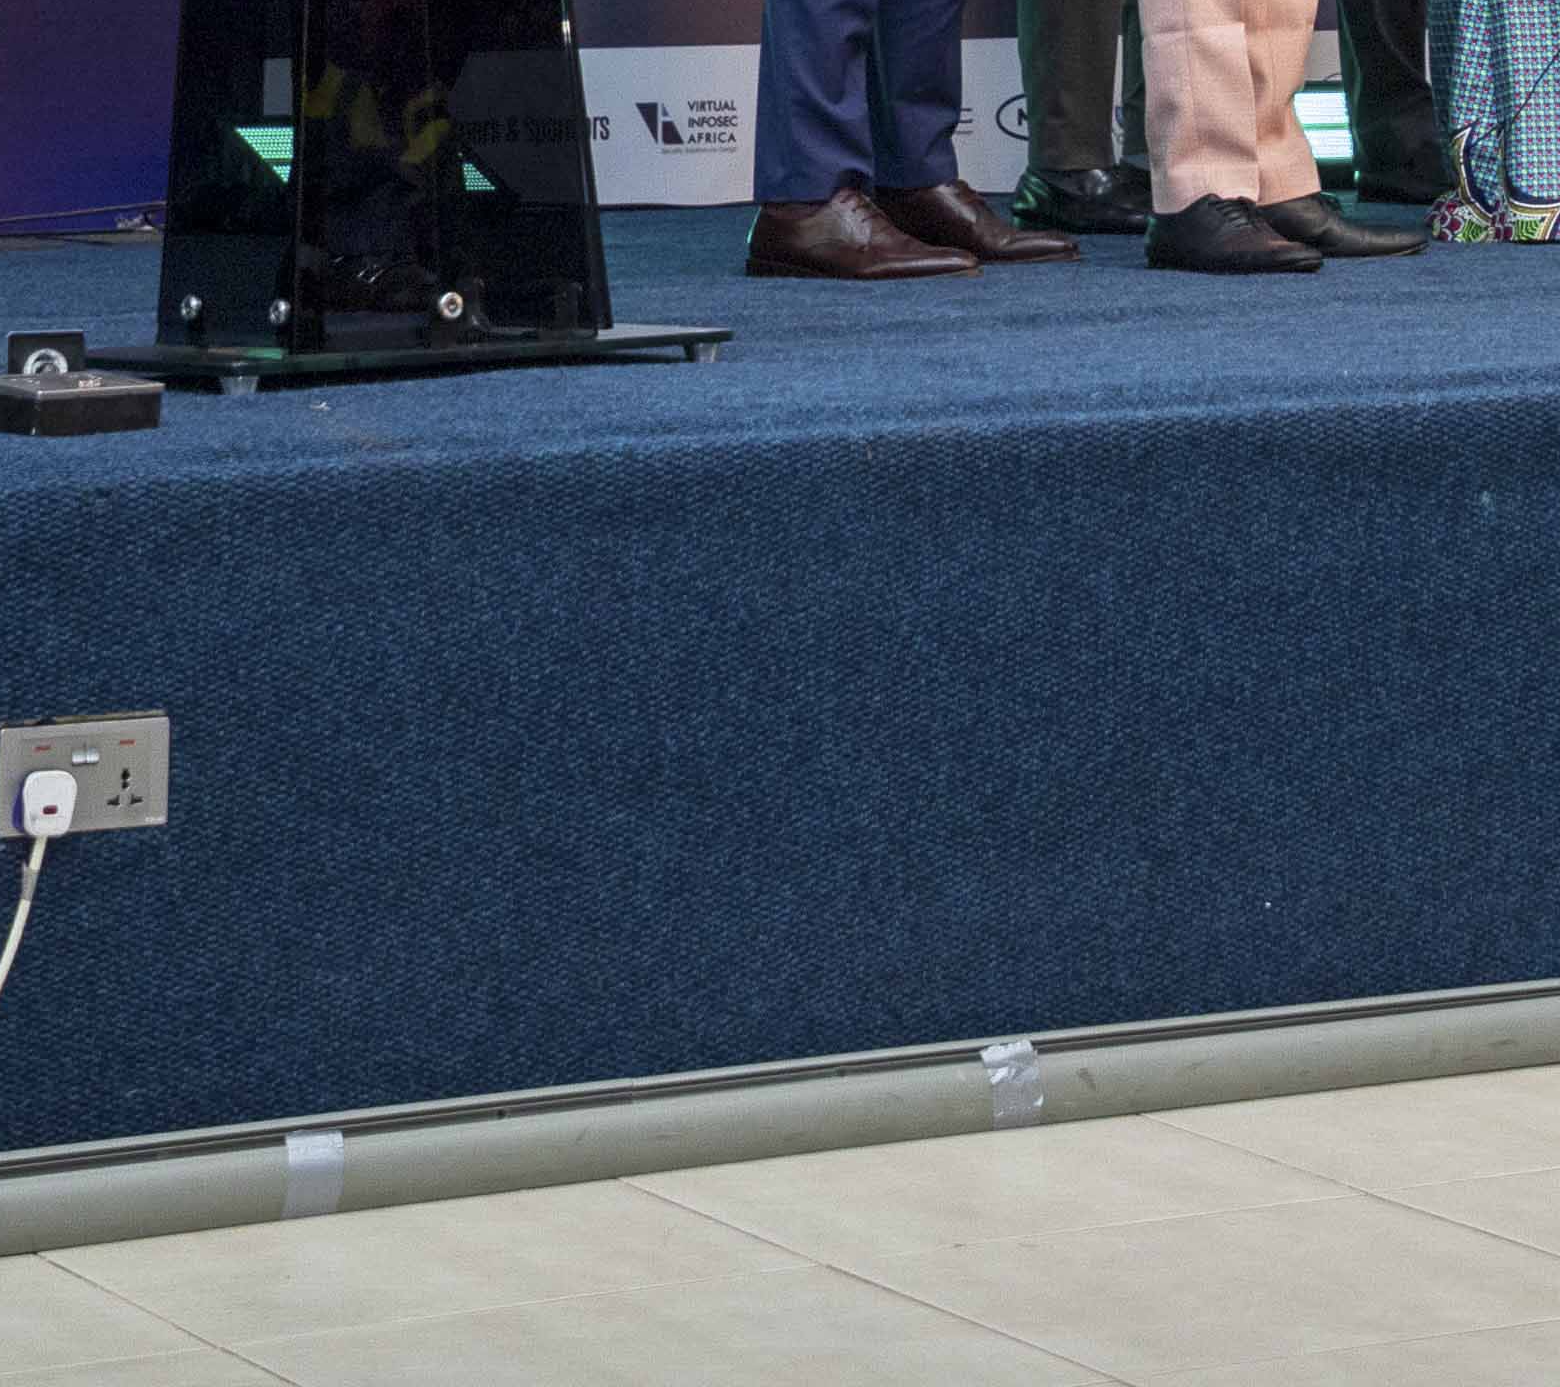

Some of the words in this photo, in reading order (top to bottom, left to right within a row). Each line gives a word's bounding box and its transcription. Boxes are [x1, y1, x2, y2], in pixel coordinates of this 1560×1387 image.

[687, 100, 737, 112] VIRTUAL
[687, 116, 738, 128] INFOSEC
[687, 132, 737, 144] AFRICA
